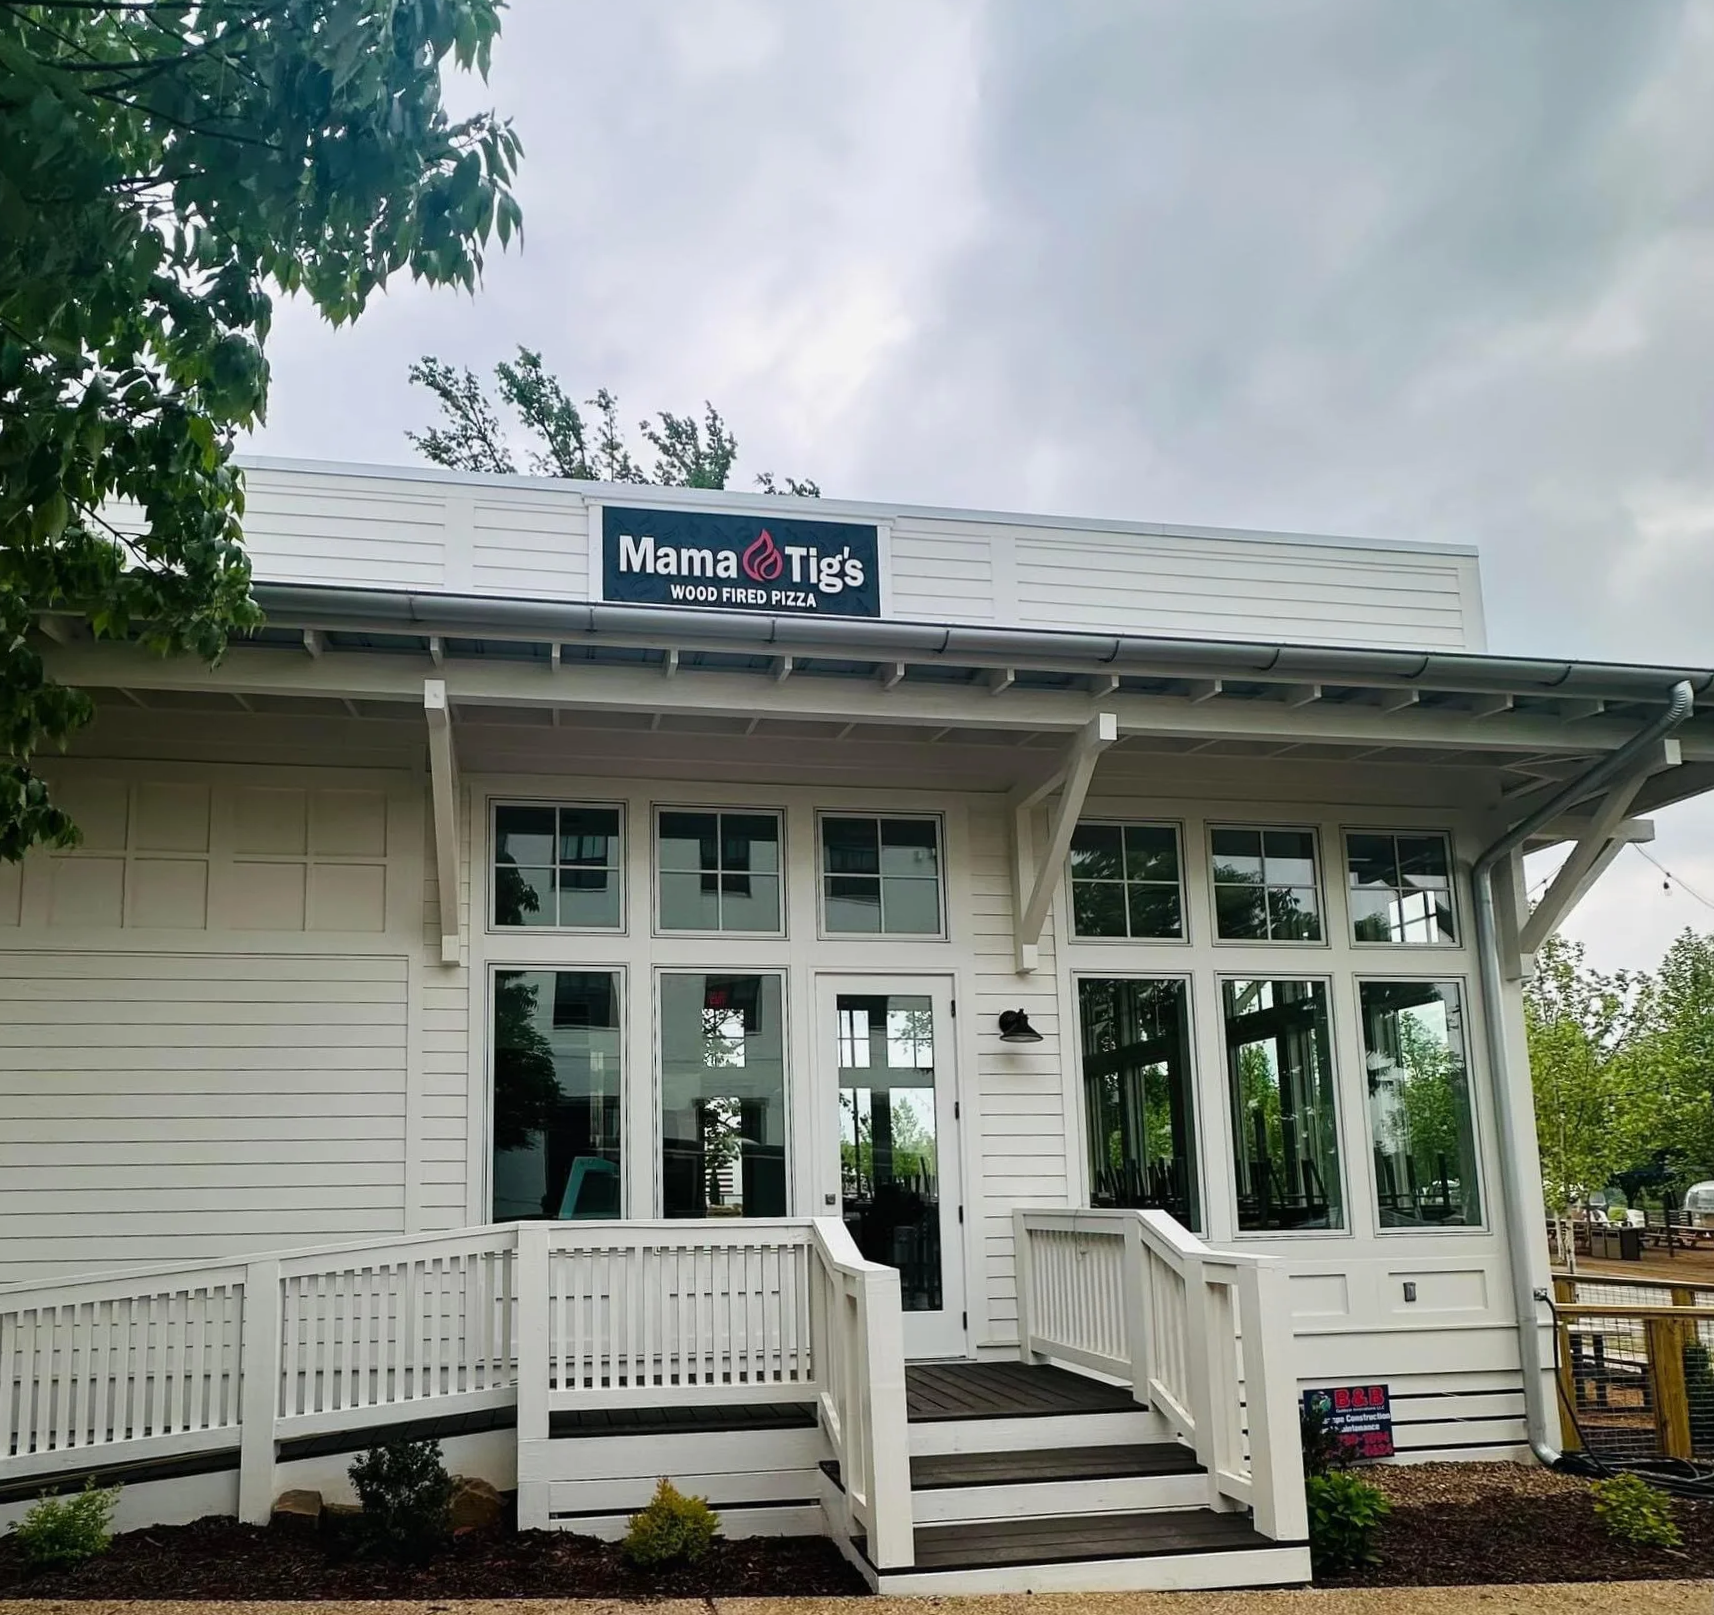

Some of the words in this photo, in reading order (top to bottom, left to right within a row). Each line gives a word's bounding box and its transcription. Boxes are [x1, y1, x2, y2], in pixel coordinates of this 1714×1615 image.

[619, 535, 738, 578] Mama
[784, 545, 865, 594] Tig's
[670, 584, 718, 602] WOOD
[722, 587, 767, 604] FIRED
[771, 590, 817, 608] PIZZA
[1334, 1387, 1385, 1408] B&B
[1345, 1412, 1391, 1423] Construction
